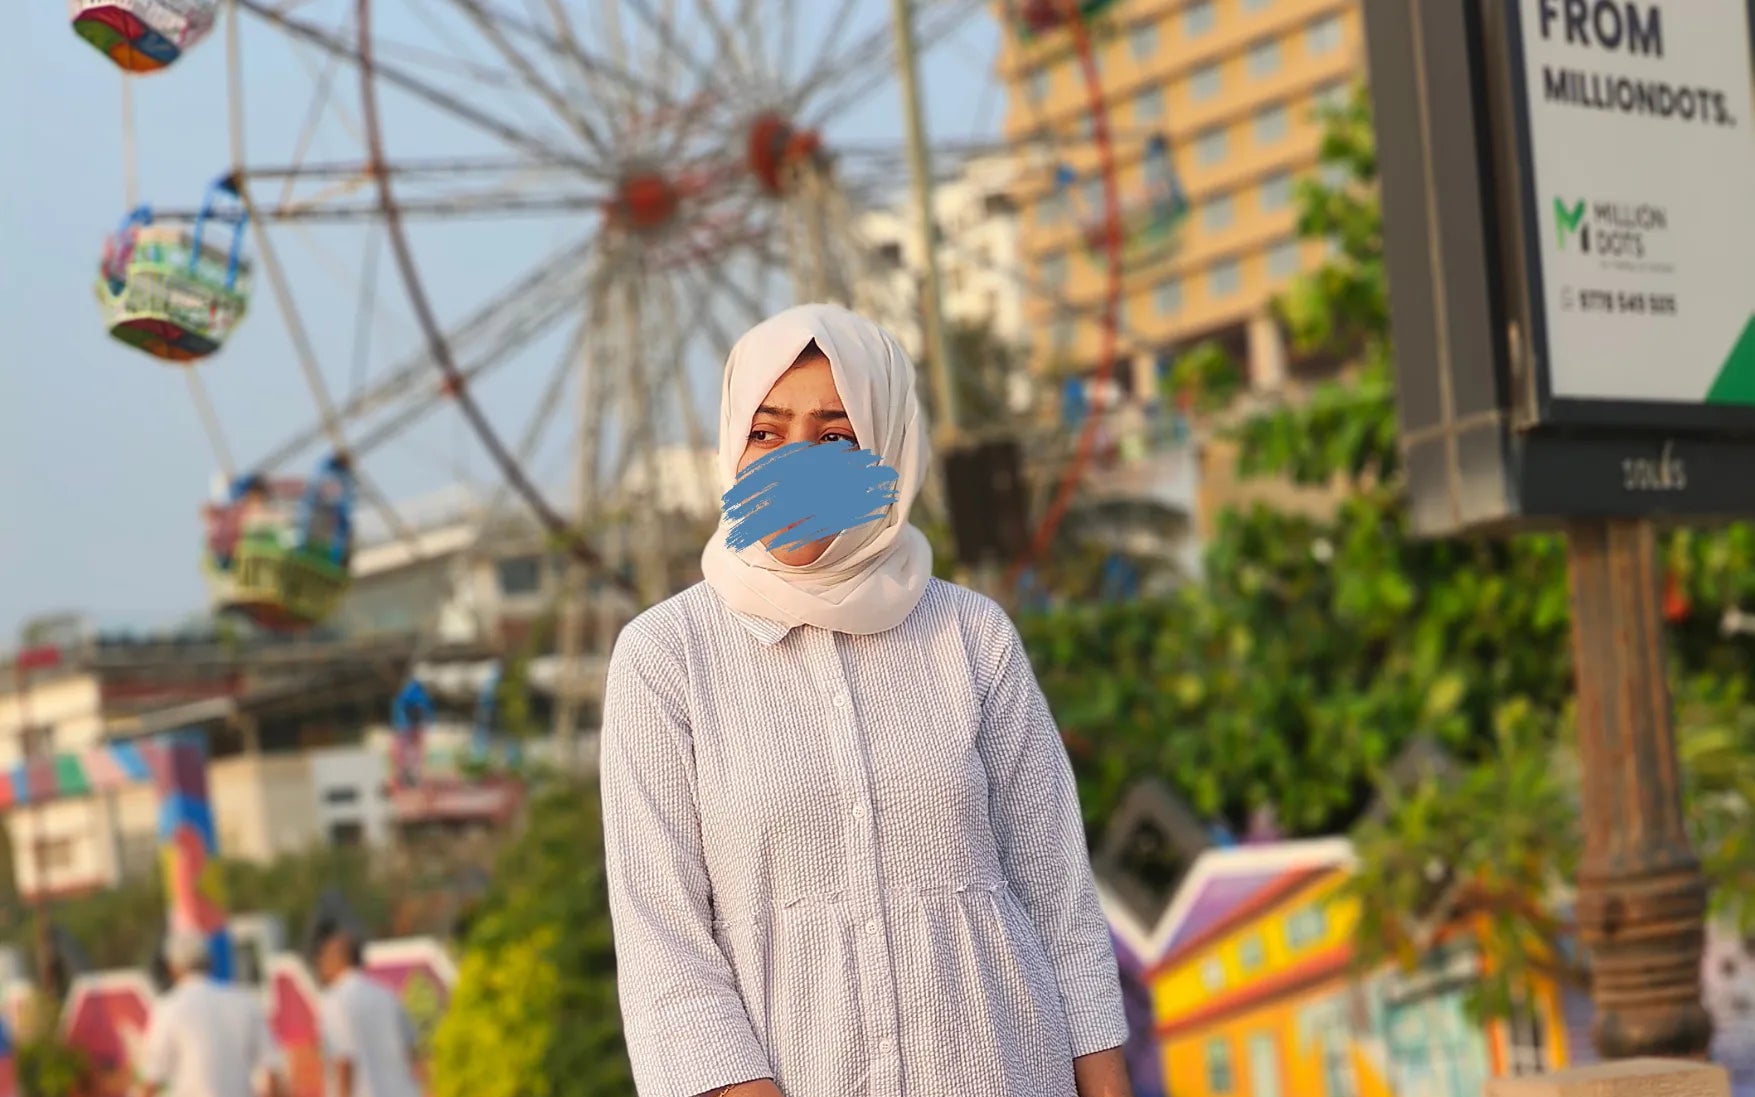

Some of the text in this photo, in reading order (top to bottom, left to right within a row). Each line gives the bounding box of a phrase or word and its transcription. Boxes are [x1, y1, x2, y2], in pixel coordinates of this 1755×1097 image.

[1537, 0, 1664, 58] FROM
[1543, 65, 1737, 126] MILLIONDOTS.
[1594, 202, 1668, 231] MILLION
[1597, 229, 1645, 257] DOTS
